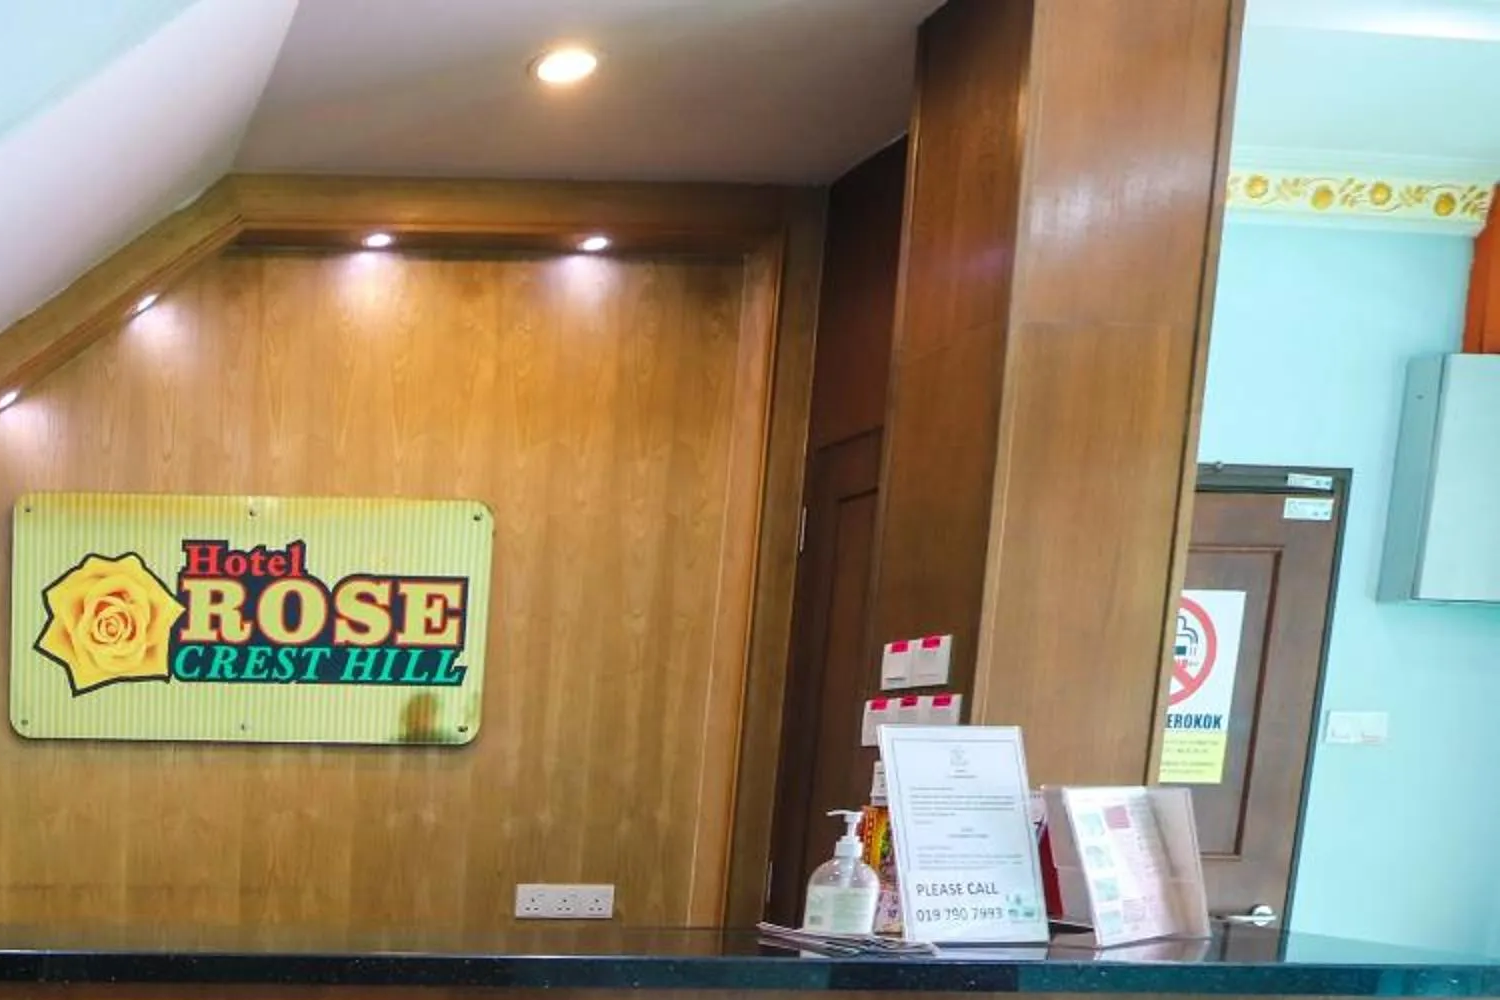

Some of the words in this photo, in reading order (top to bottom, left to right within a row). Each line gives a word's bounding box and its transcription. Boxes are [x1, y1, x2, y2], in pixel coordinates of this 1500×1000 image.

[184, 542, 306, 577] Hotel
[178, 578, 466, 647] ROSE
[174, 645, 331, 682] CREST
[340, 648, 466, 684] HILL
[1166, 713, 1223, 729] EROKOK
[916, 882, 964, 896] PLEASE
[967, 881, 999, 895] CALL
